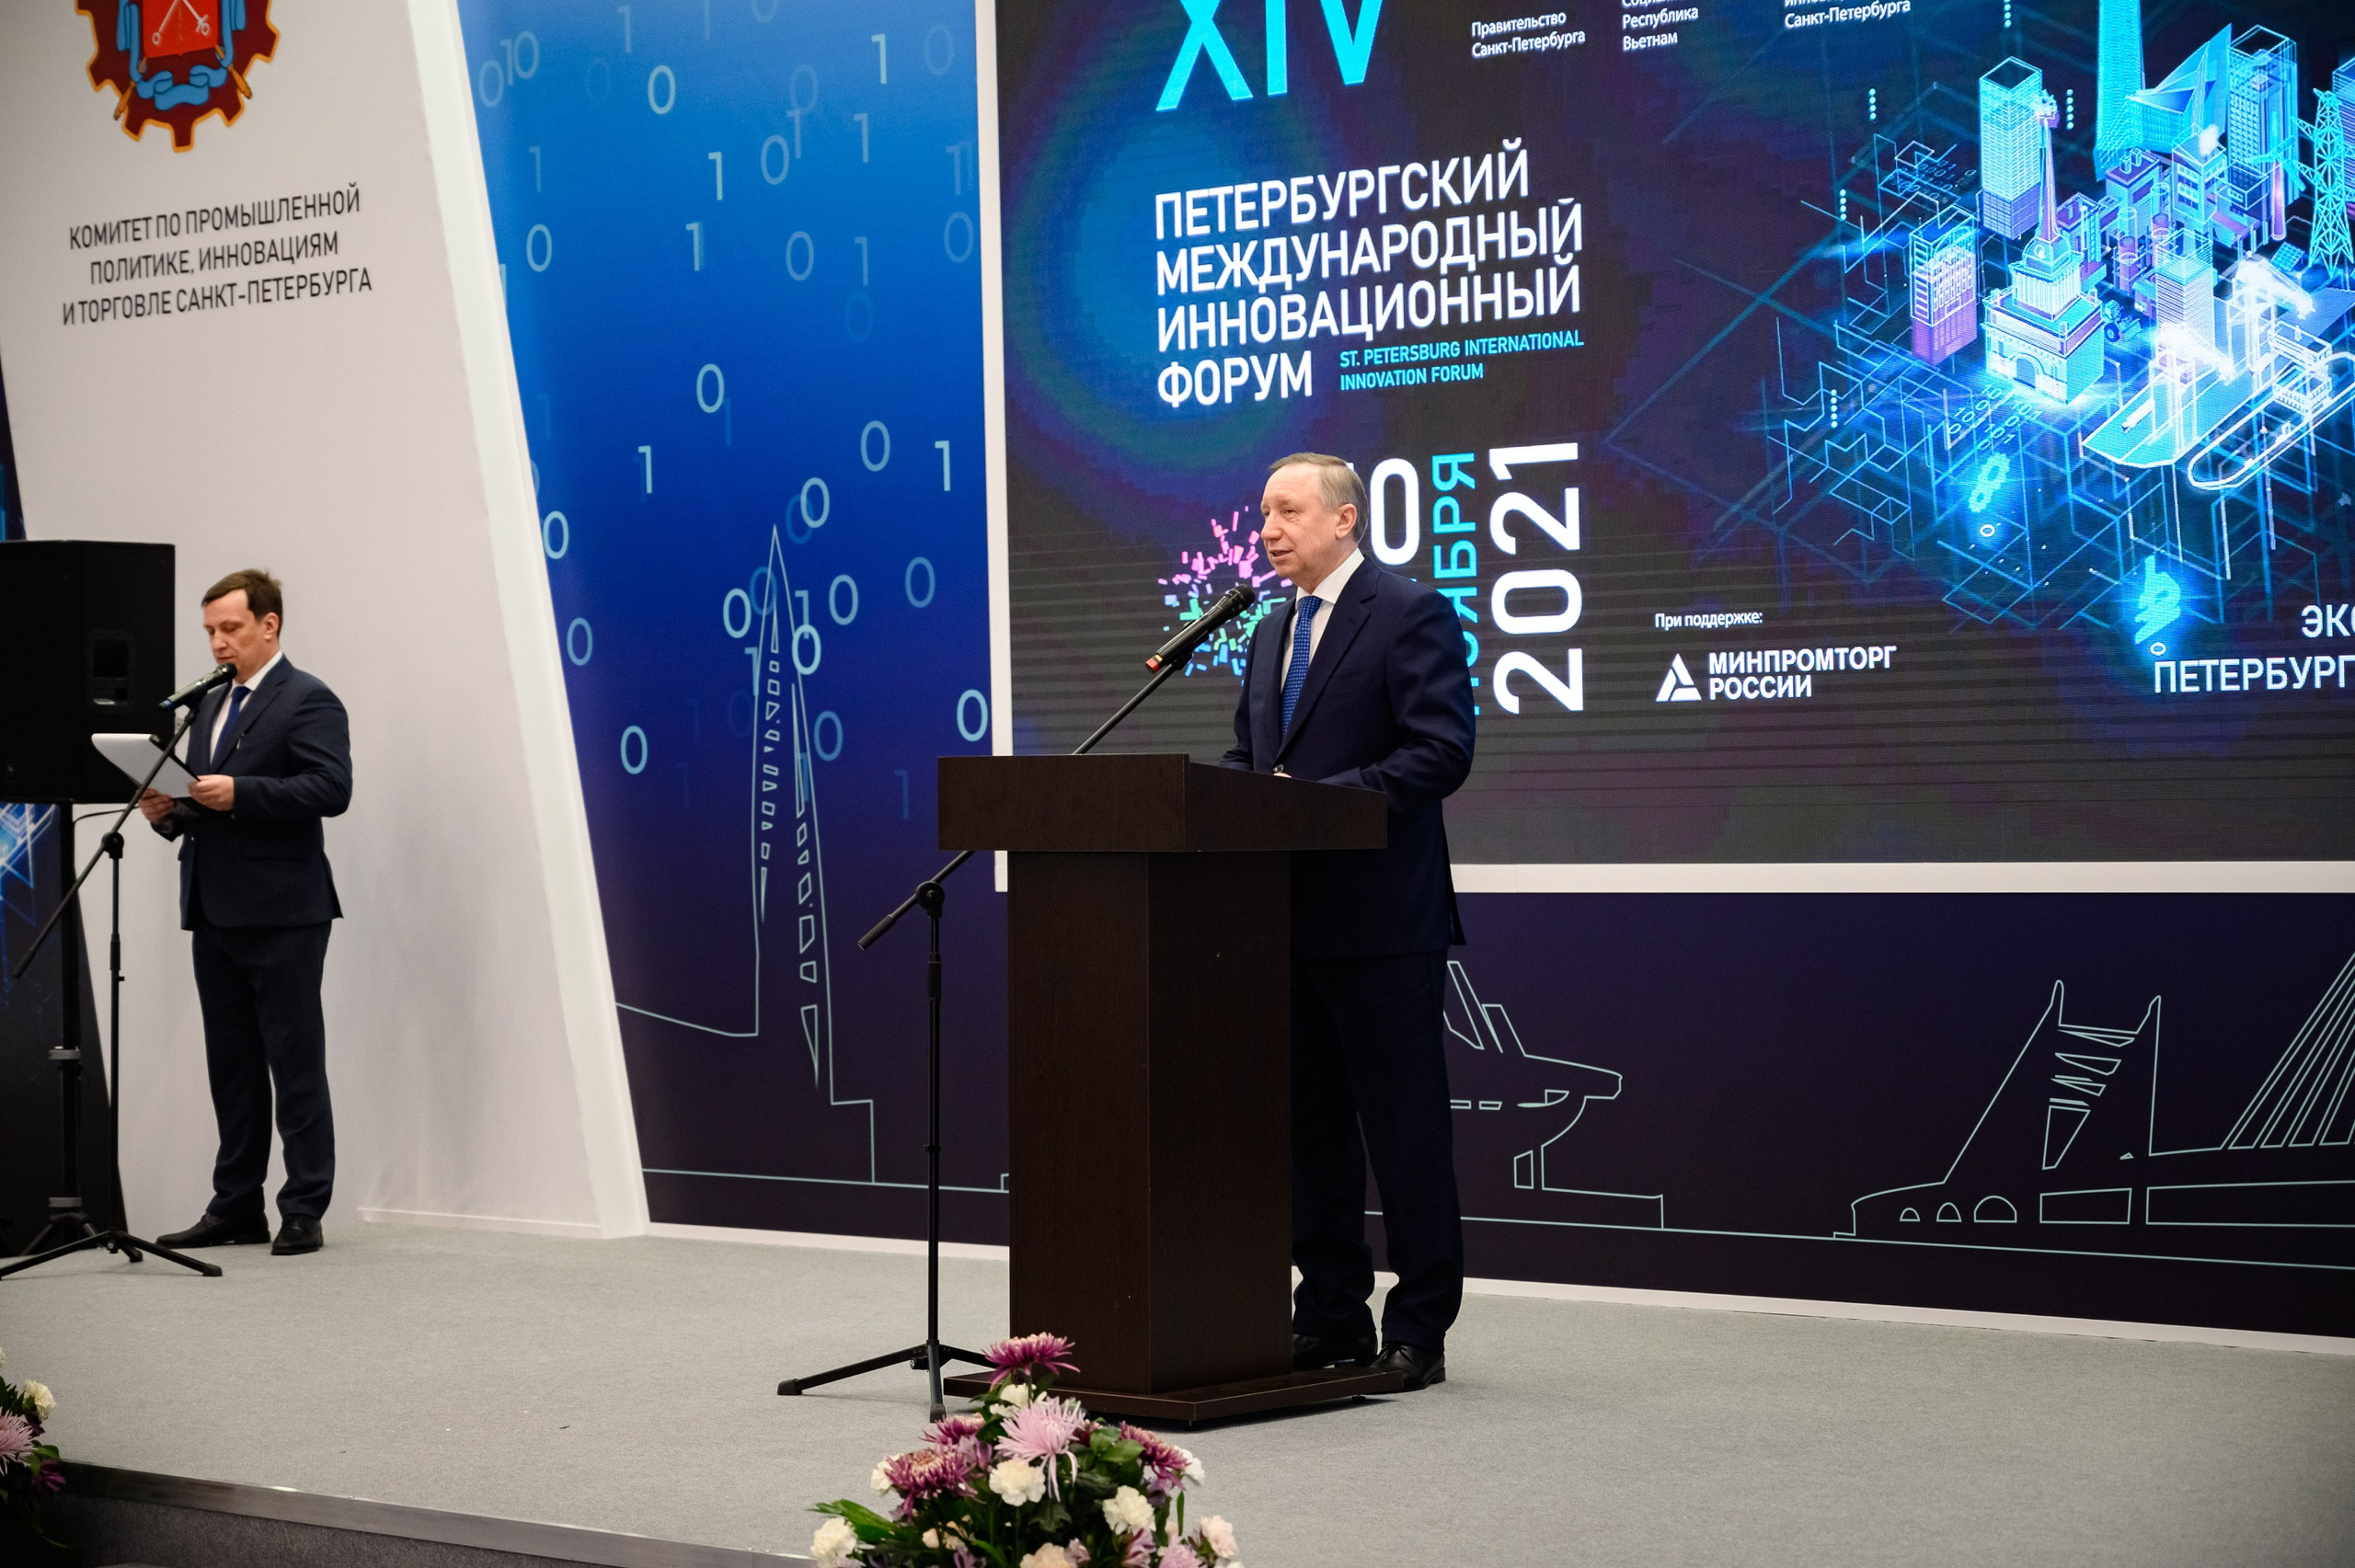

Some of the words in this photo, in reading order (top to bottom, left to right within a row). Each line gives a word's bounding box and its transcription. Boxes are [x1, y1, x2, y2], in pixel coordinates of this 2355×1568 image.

[1472, 12, 1568, 38] Правительство
[1623, 7, 1699, 29] Республика
[1785, 1, 1912, 29] Санкт-Петербурга
[1156, 0, 1382, 111] XIV
[1472, 31, 1586, 58] Санкт-Петербурга
[1623, 32, 1679, 52] Вьетнам
[1155, 137, 1529, 240] ПЕТЕРБУРГСКИЙ
[70, 216, 153, 249] КОМИТЕТ
[156, 212, 181, 238] ПО
[186, 182, 361, 235] ПРОМЫШЛЕННОЙ
[90, 249, 194, 284] ПОЛИТИКЕ,
[199, 231, 339, 271] ИННОВАЦИЯМ
[1156, 198, 1582, 295] МЕЖДУНАРОДНЫЙ
[63, 303, 75, 325] И
[78, 291, 172, 324] ТОРГОВЛЕ
[176, 267, 373, 313] САНКТ-ПЕТЕРБУРГА
[1157, 252, 1580, 352] ИННОВАЦИОННЫЙ
[1339, 349, 1361, 368] ST.
[1365, 342, 1461, 366] PETERSBURG
[1464, 329, 1584, 357] INTERNATIONAL
[1157, 349, 1313, 407] ФОРУМ
[1339, 368, 1428, 391] INNOVATION
[1431, 363, 1485, 383] FORUM
[1347, 457, 1420, 566] 0
[1488, 442, 1584, 715] 2021
[1655, 613, 1683, 630] При
[1684, 612, 1763, 628] поддержке:
[2301, 603, 2355, 638] ЭК
[1708, 646, 1897, 674] МИНПРОМТОРГ
[1709, 675, 1812, 700] РОССИИ
